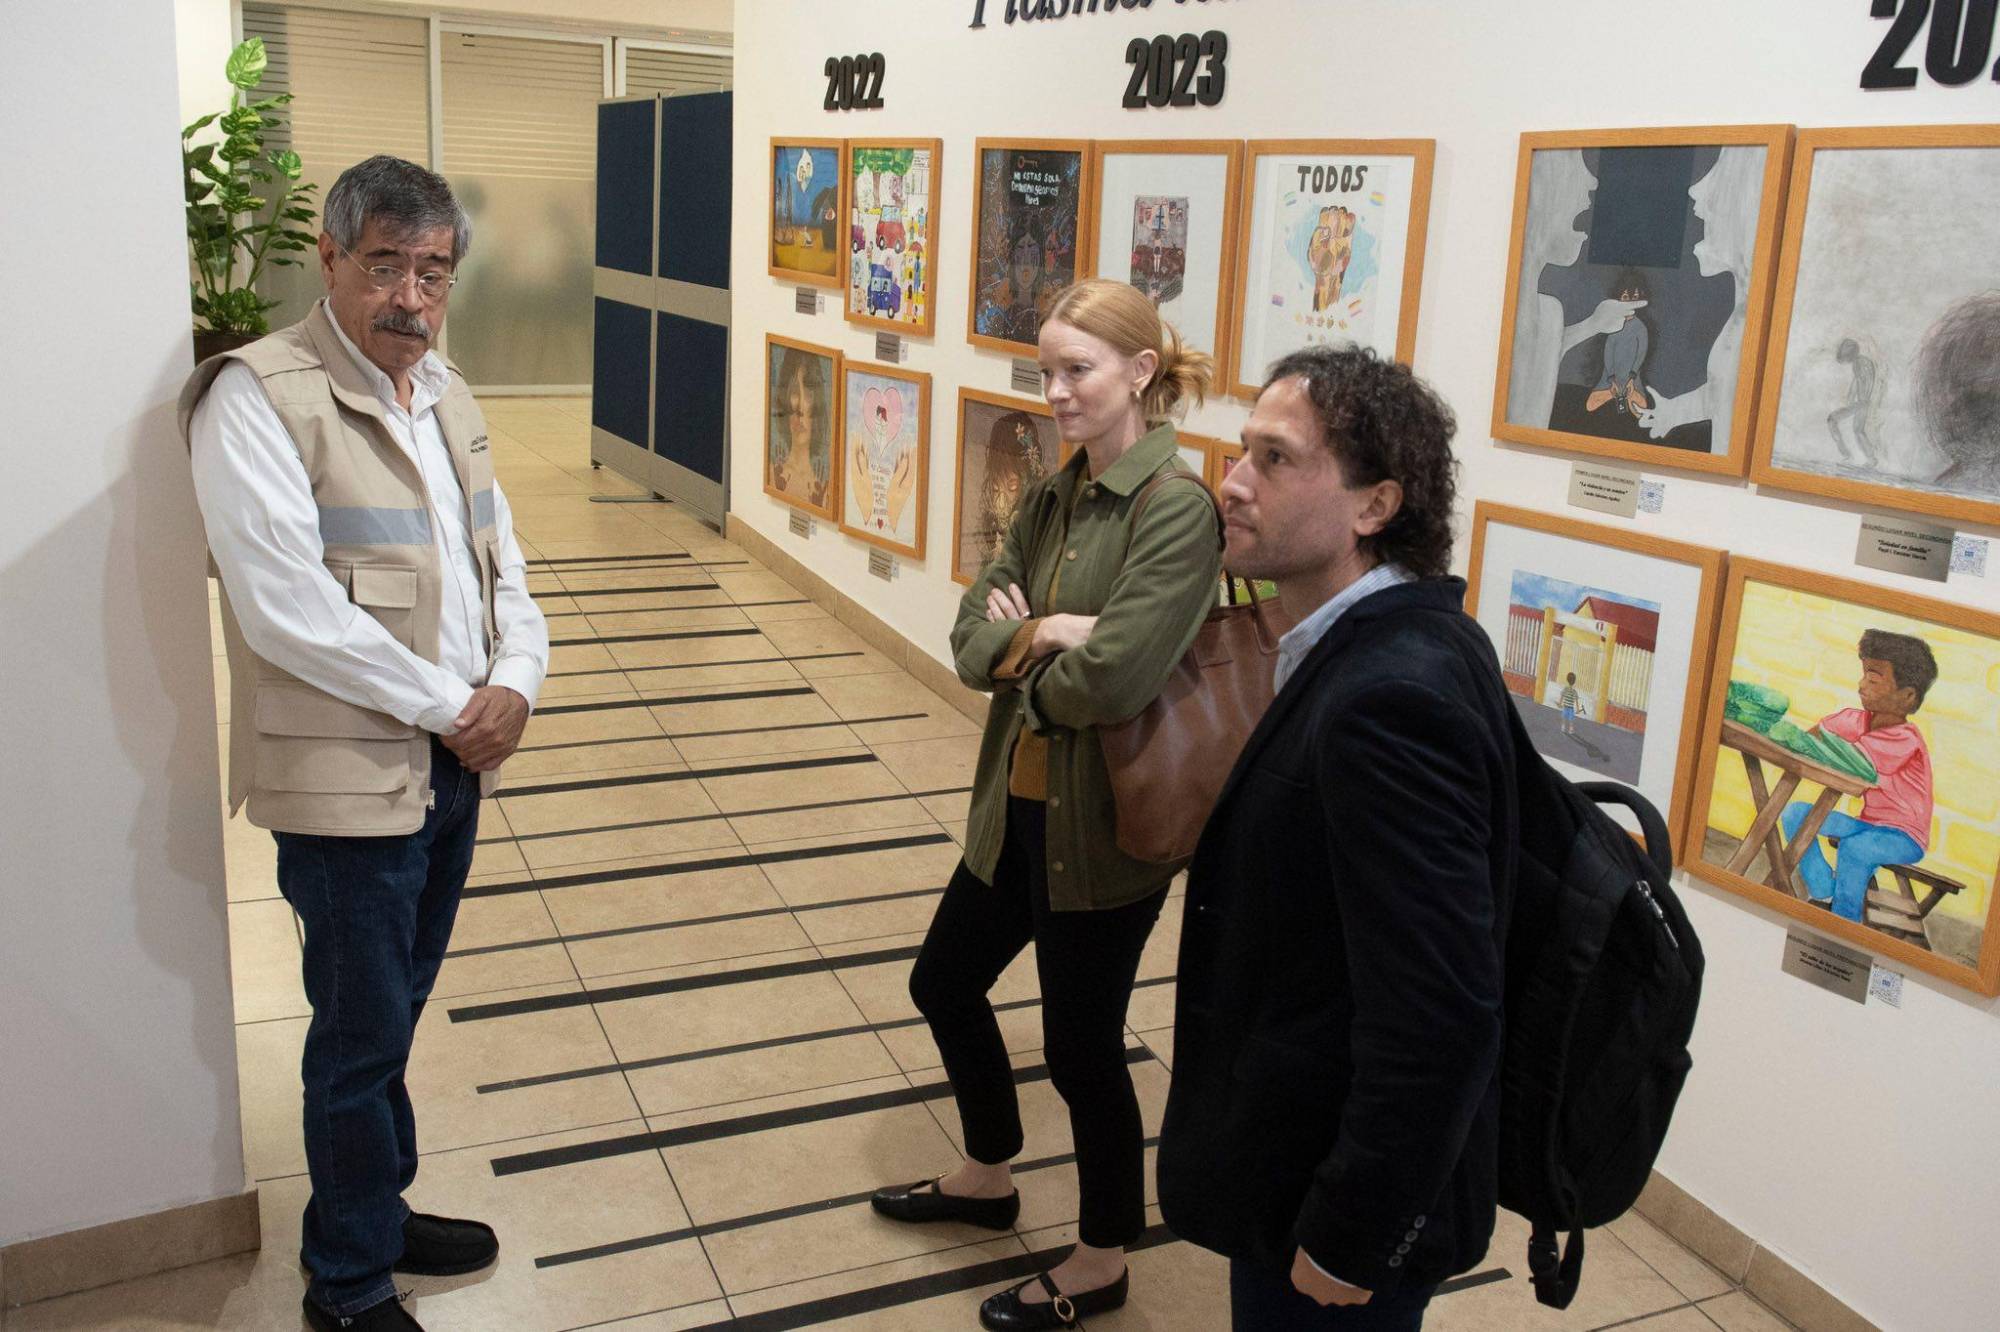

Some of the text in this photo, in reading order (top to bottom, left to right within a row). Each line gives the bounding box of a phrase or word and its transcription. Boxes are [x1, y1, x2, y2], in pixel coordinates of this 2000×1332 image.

[1122, 29, 1228, 108] 2023
[1860, 0, 2000, 89] 20
[823, 52, 886, 111] 2022
[1297, 165, 1369, 194] TODOS
